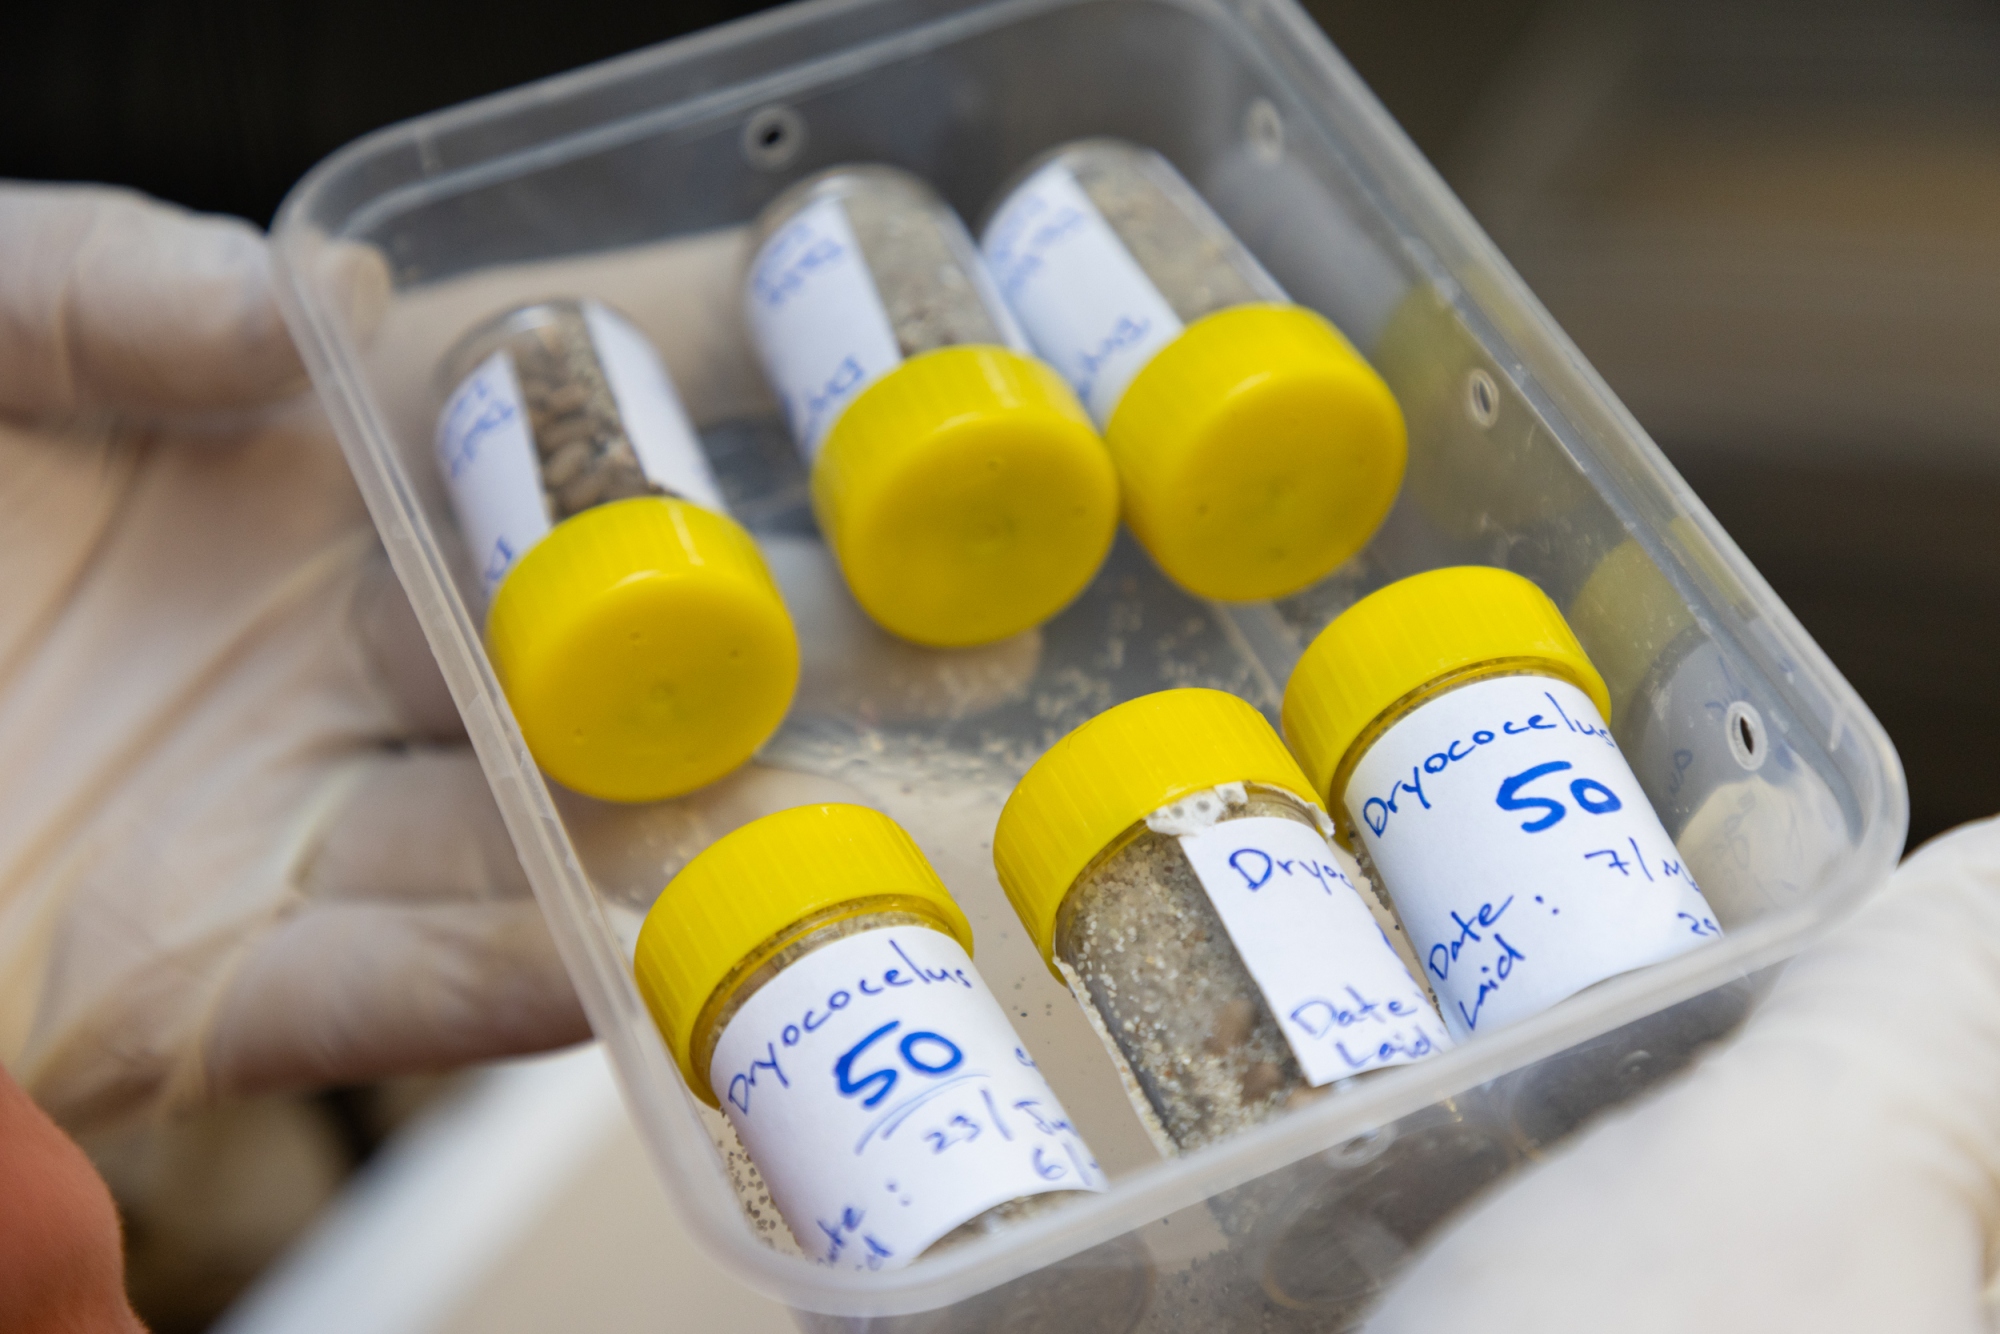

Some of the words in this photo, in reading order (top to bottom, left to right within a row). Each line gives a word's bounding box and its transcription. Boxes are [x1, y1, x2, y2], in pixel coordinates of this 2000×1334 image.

[1363, 692, 1616, 838] Dryococelus
[1496, 761, 1622, 833] 50
[1429, 895, 1514, 980] Date
[1289, 984, 1418, 1040] Date
[1459, 933, 1525, 1031] Laid
[728, 938, 973, 1115] Dryococelus
[834, 1019, 964, 1108] 50
[1335, 1024, 1434, 1069] Laid
